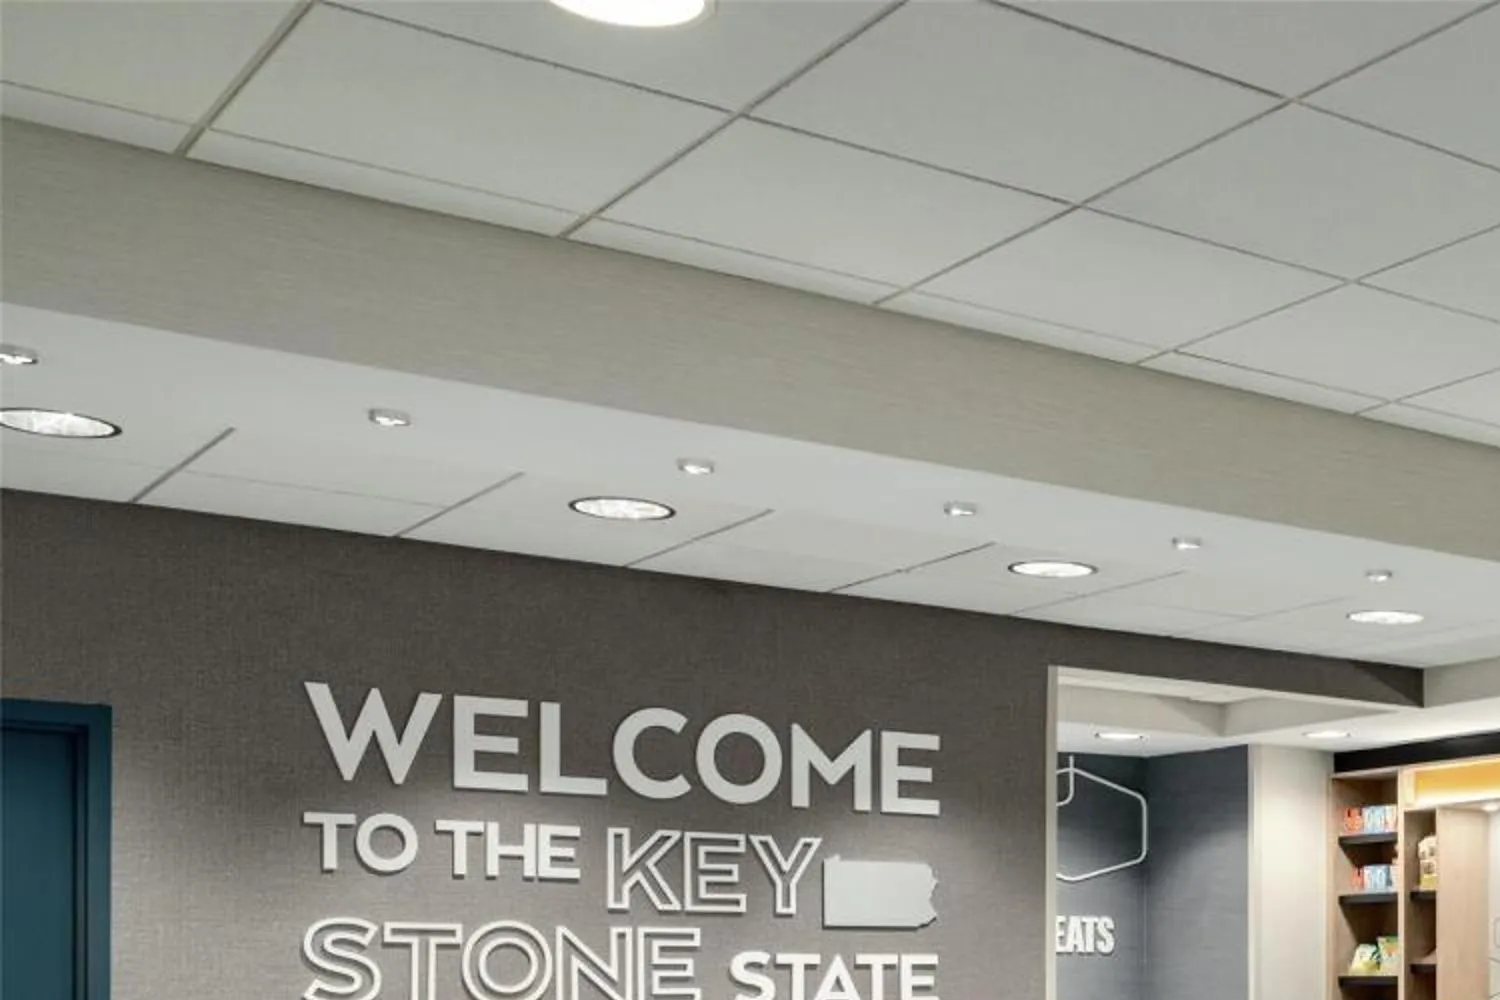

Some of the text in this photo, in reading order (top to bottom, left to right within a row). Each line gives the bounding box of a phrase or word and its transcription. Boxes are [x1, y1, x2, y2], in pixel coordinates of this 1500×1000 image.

[303, 681, 940, 816] WELCOME
[303, 812, 822, 915] TO THE KEY
[1055, 915, 1115, 953] EATS
